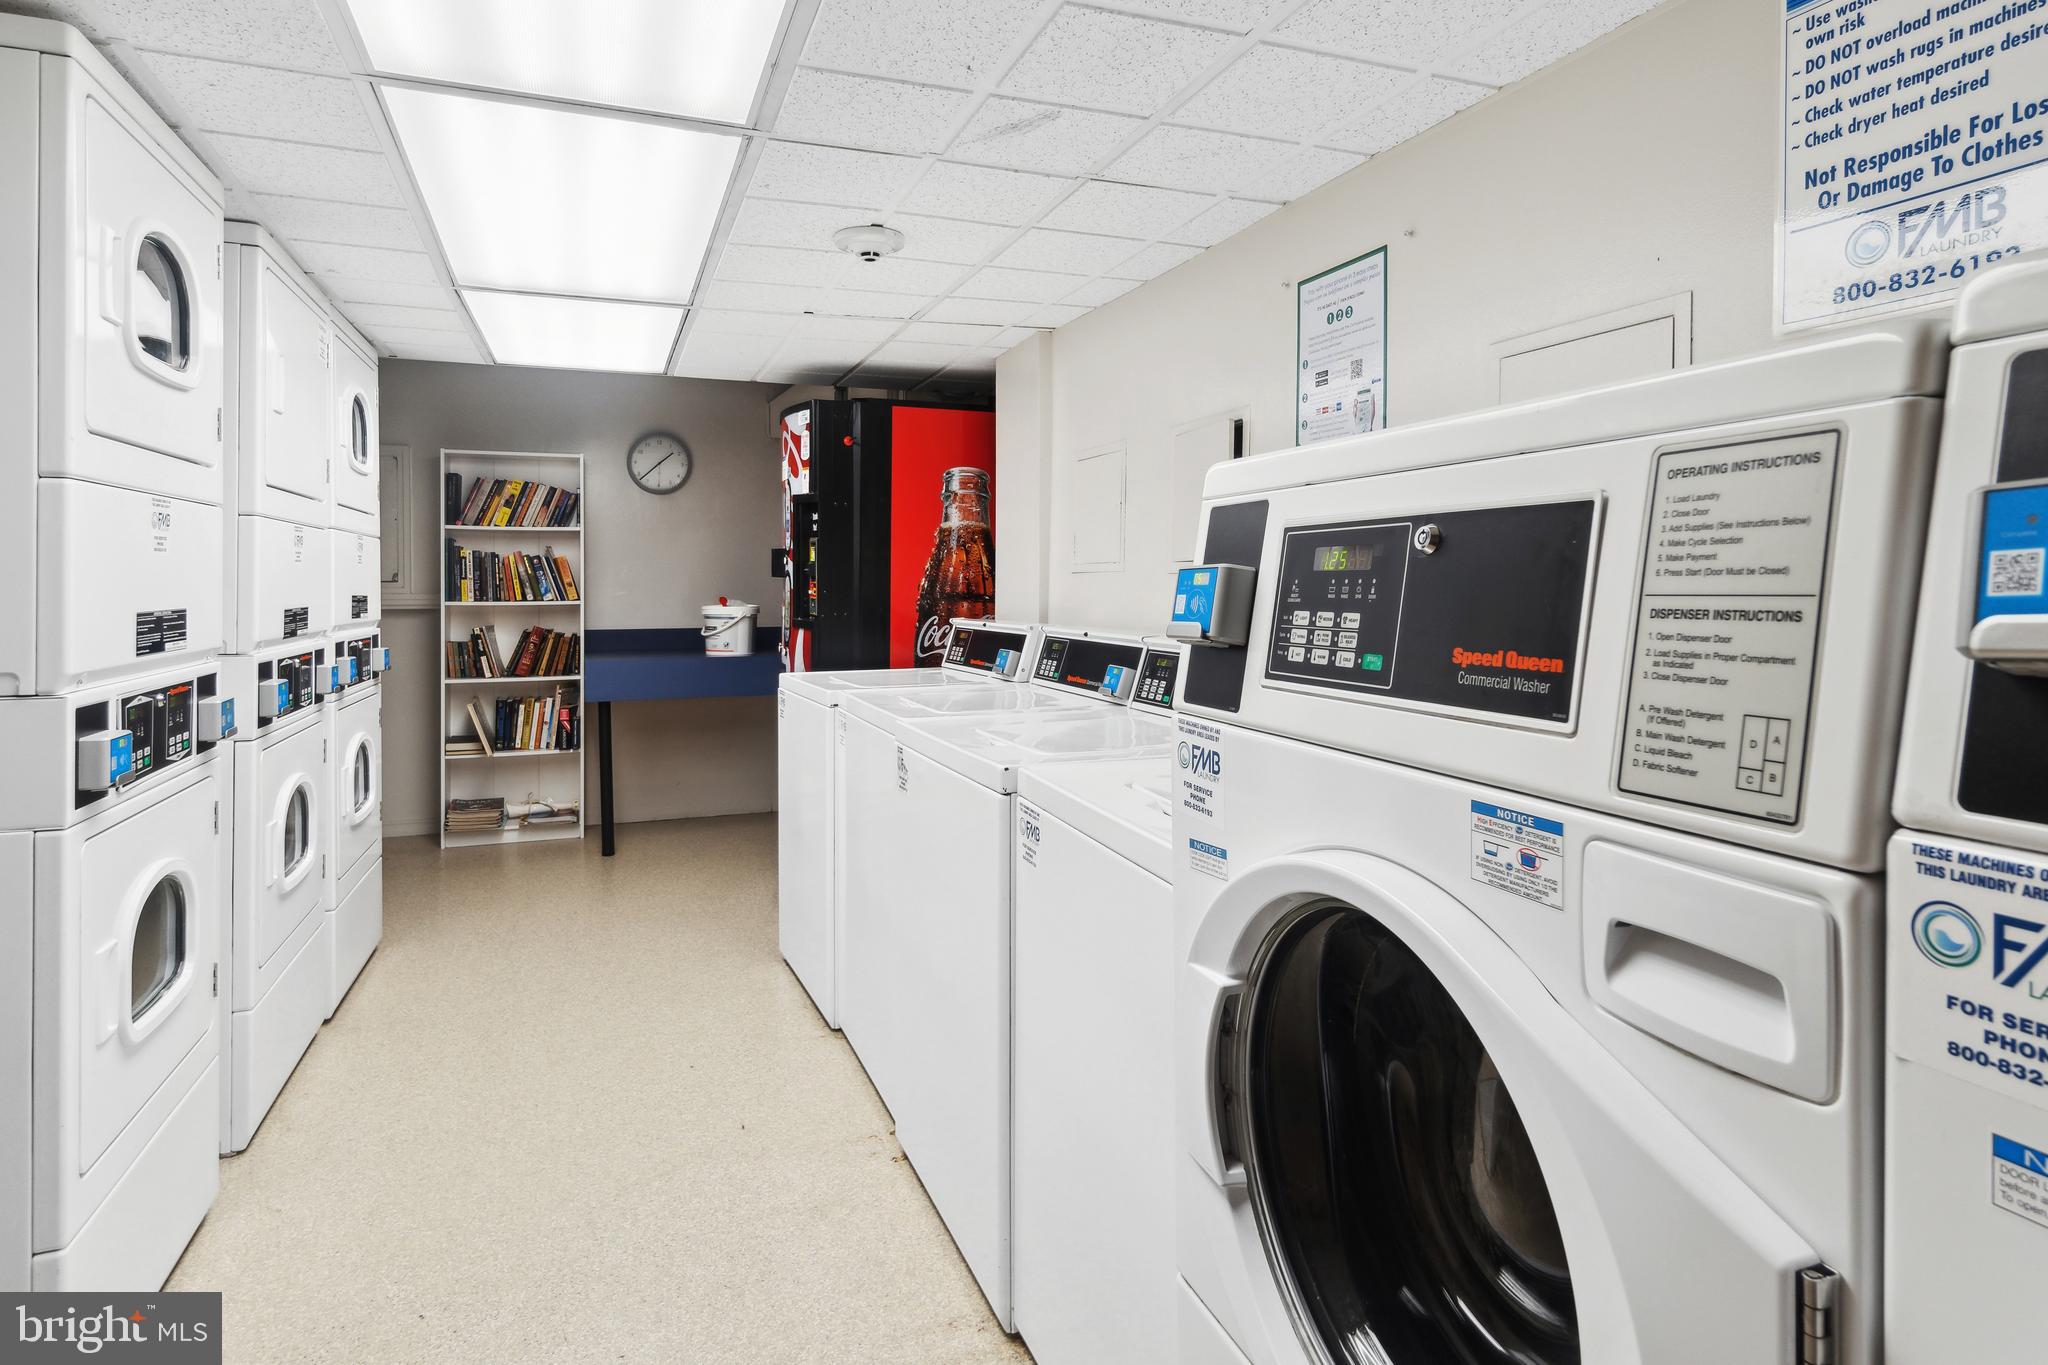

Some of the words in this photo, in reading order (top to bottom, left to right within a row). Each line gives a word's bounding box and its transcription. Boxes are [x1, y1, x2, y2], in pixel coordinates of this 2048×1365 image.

[1806, 13, 1830, 31] Use
[1806, 29, 1835, 49] own
[1840, 12, 1866, 35] risk
[1805, 55, 1826, 74] DO
[1830, 39, 1862, 64] NOT
[1866, 8, 1930, 50] overload
[1805, 80, 1825, 99] DO
[1830, 65, 1861, 90] NOT
[1866, 48, 1905, 75] wash
[1910, 37, 1943, 59] rugs
[1949, 28, 1963, 43] in
[1969, 0, 2047, 35] machines
[1805, 98, 1843, 123] Check
[1848, 84, 1891, 108] water
[1897, 44, 1994, 90] temperature
[1805, 124, 1842, 148] Check
[1848, 111, 1886, 134] dryer
[1892, 96, 1924, 119] heat
[1930, 69, 1989, 105] desired
[1805, 165, 1837, 190] Not
[1844, 124, 1961, 177] Responsible
[1969, 113, 2004, 138] For
[1818, 190, 1840, 209] Or
[1848, 167, 1924, 202] Damage
[1931, 154, 1954, 177] To
[1962, 130, 2044, 167] Clothes
[1898, 184, 2007, 259] FMB
[1920, 226, 2003, 256] LAUNDRY
[1668, 463, 1728, 480] OPERATING
[1731, 452, 1822, 472] INSTRUCTIONS
[1673, 494, 1690, 503] Load
[1692, 492, 1720, 502] Laundry
[1672, 510, 1690, 518] Close
[1692, 508, 1710, 516] Door
[1669, 524, 1682, 532] Add
[1684, 522, 1714, 532] Supplies
[1716, 521, 1733, 530] (See
[1736, 518, 1779, 528] Instructions
[1782, 516, 1811, 526] Below)
[1668, 539, 1686, 547] Make
[1688, 538, 1707, 548] Cycle
[1710, 536, 1743, 545] Selection
[1686, 553, 1717, 562] Payment
[1685, 568, 1701, 576] Start
[1704, 568, 1723, 577] (Door
[1758, 567, 1790, 576] Closed)
[1650, 608, 1710, 620] DISPENSER
[1713, 610, 1803, 622] INSTRUCTIONS
[1656, 632, 1674, 641] Open
[1676, 633, 1712, 643] Dispenser
[1713, 635, 1733, 643] Door
[1452, 648, 1504, 668] Speed
[1505, 650, 1564, 672] Queen
[1654, 649, 1670, 657] Load
[1672, 650, 1702, 660] Supplies
[1713, 652, 1738, 663] Proper
[1740, 654, 1796, 665] Compartment
[1662, 660, 1694, 669] Indicated
[1458, 671, 1510, 689] Commercial
[1514, 677, 1551, 694] Washer
[1651, 672, 1670, 681] Close
[1672, 674, 1707, 684] Dispenser
[1710, 676, 1728, 686] Door
[1649, 705, 1661, 714] Pre
[1663, 707, 1684, 716] Wash
[1685, 709, 1724, 721] Detergent
[1655, 716, 1686, 728] Offered)
[1645, 730, 1662, 739] Main
[1665, 733, 1686, 742] Wash
[1687, 736, 1726, 749] Detergent
[1192, 744, 1220, 775] FMB
[1634, 744, 1641, 752] C.
[1644, 744, 1666, 757] Liquid
[1667, 749, 1693, 760] Bleach
[1633, 758, 1640, 767] D.
[1642, 760, 1664, 771] Fabric
[1667, 764, 1699, 777] Softener
[1198, 770, 1220, 784] LAUNDRY
[1746, 776, 1754, 784] C
[1184, 781, 1192, 789] FOR
[1193, 784, 1212, 797] SERVICE
[1190, 792, 1206, 804] PHONE
[1497, 808, 1535, 826] NOTICE
[1194, 841, 1222, 856] NOTICE
[1912, 843, 1953, 862] THESE
[1958, 852, 2035, 879] MACHINES
[1916, 861, 1945, 879] THIS
[1950, 868, 2016, 894] LAUNDRY
[1946, 994, 1994, 1023] FOR
[2002, 1012, 2048, 1040] SER
[2000, 1163, 2040, 1188] DOOR
[2000, 1188, 2014, 1202] To
